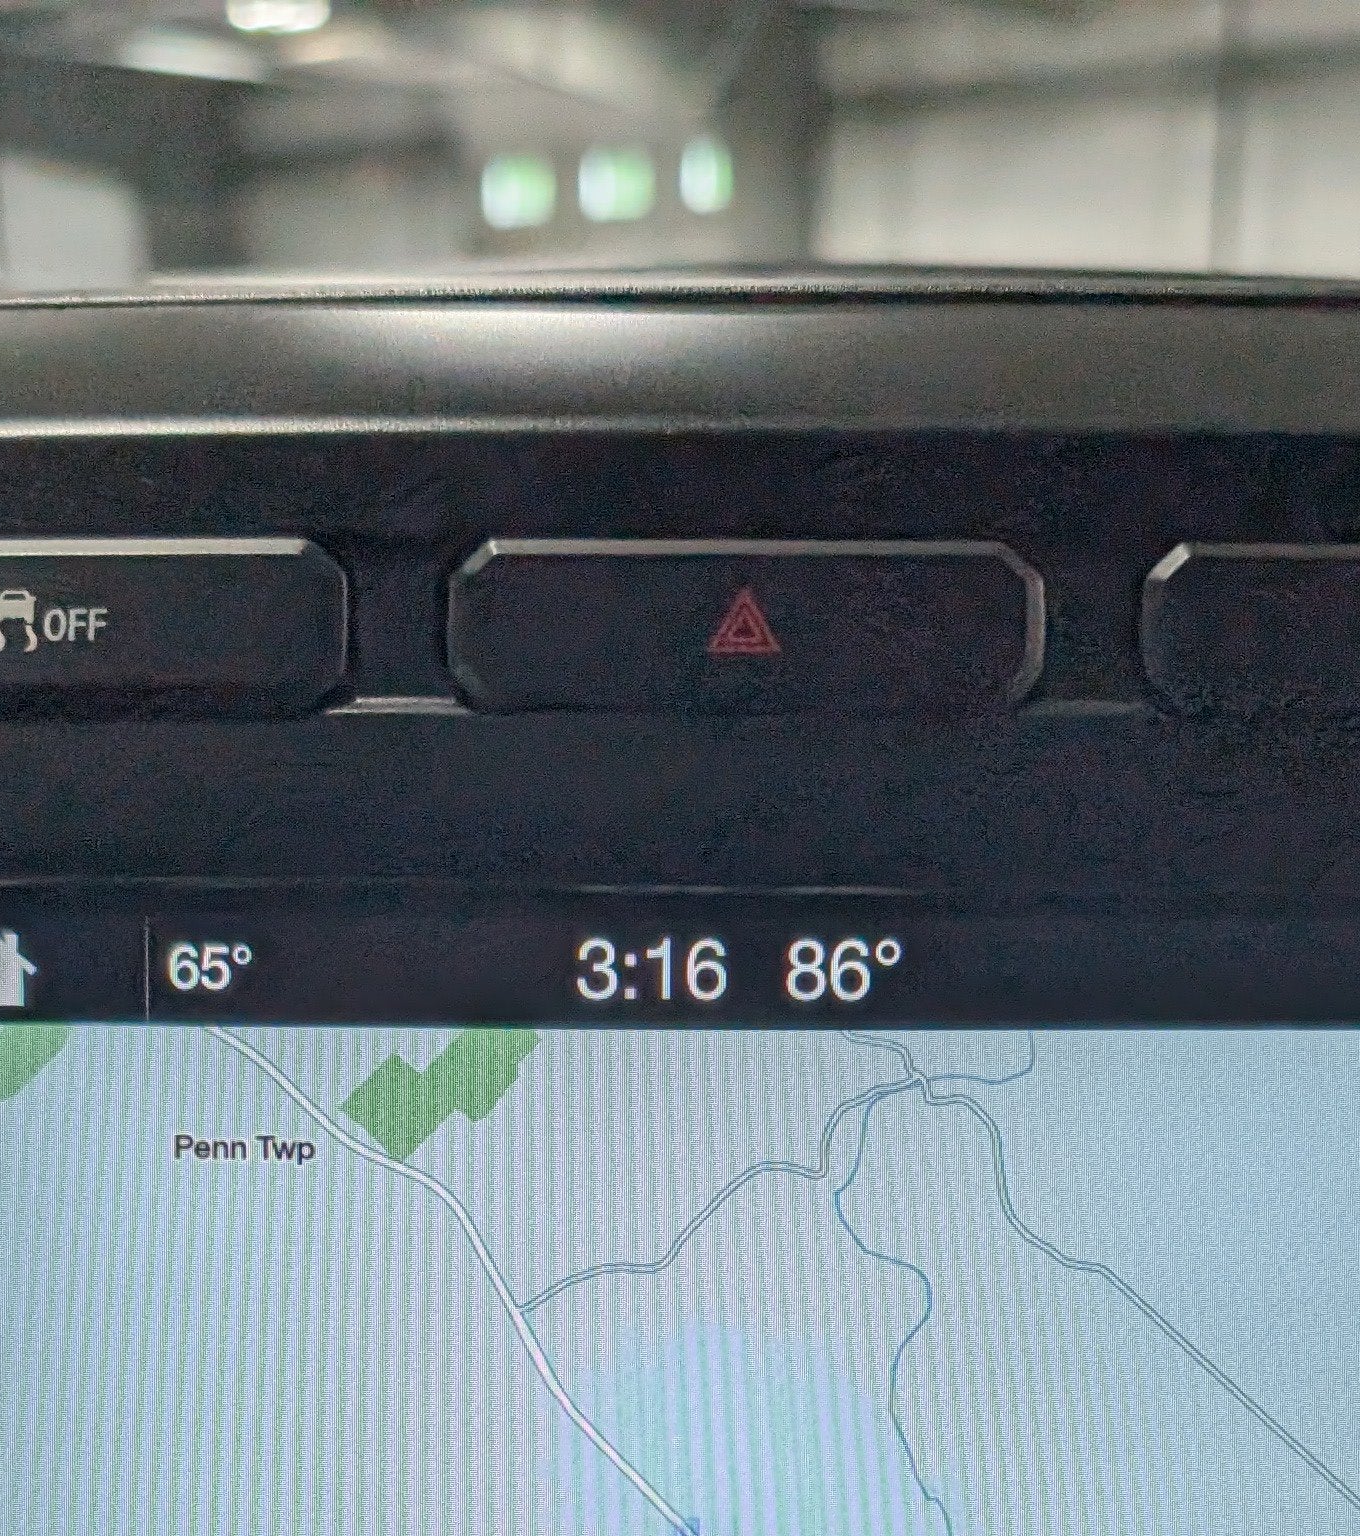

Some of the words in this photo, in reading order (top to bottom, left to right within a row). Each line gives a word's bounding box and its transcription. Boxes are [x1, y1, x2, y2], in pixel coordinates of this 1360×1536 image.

[43, 607, 108, 642] OFF
[167, 943, 254, 992] 65°
[576, 936, 728, 1001] 3:16
[785, 937, 903, 1002] 86°
[173, 1134, 246, 1160] Penn
[255, 1135, 316, 1166] Twp
